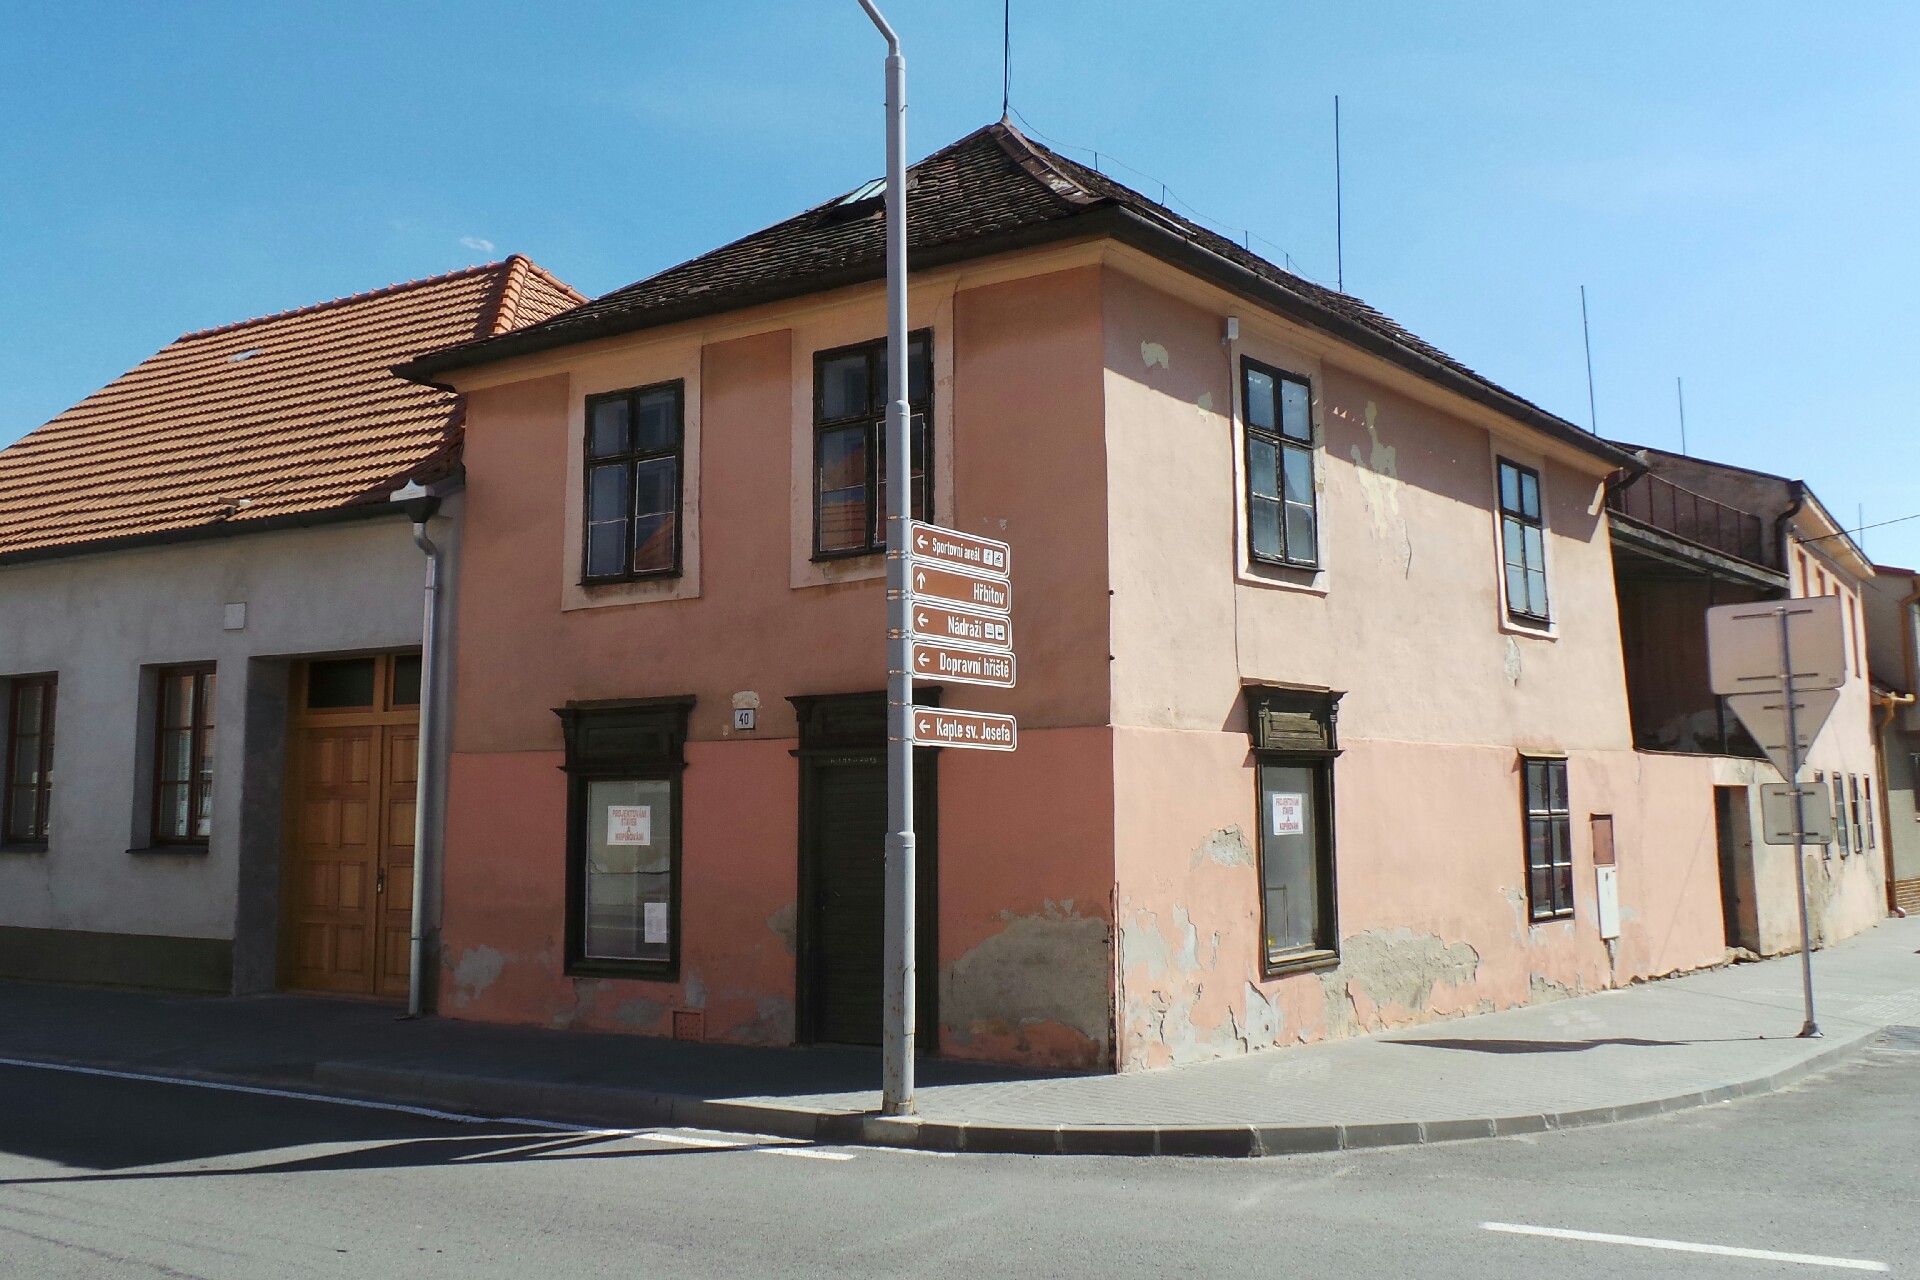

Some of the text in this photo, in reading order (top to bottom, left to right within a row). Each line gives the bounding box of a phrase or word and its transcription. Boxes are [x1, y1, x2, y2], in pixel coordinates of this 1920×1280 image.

[932, 537, 980, 561] Sportovní areál
[973, 583, 1005, 605] Hřbitov
[948, 615, 982, 638] Nádraží
[940, 652, 1009, 678] Dopravní hřiště
[739, 712, 749, 725] 40
[936, 718, 1010, 741] Kaple sv. Josefa
